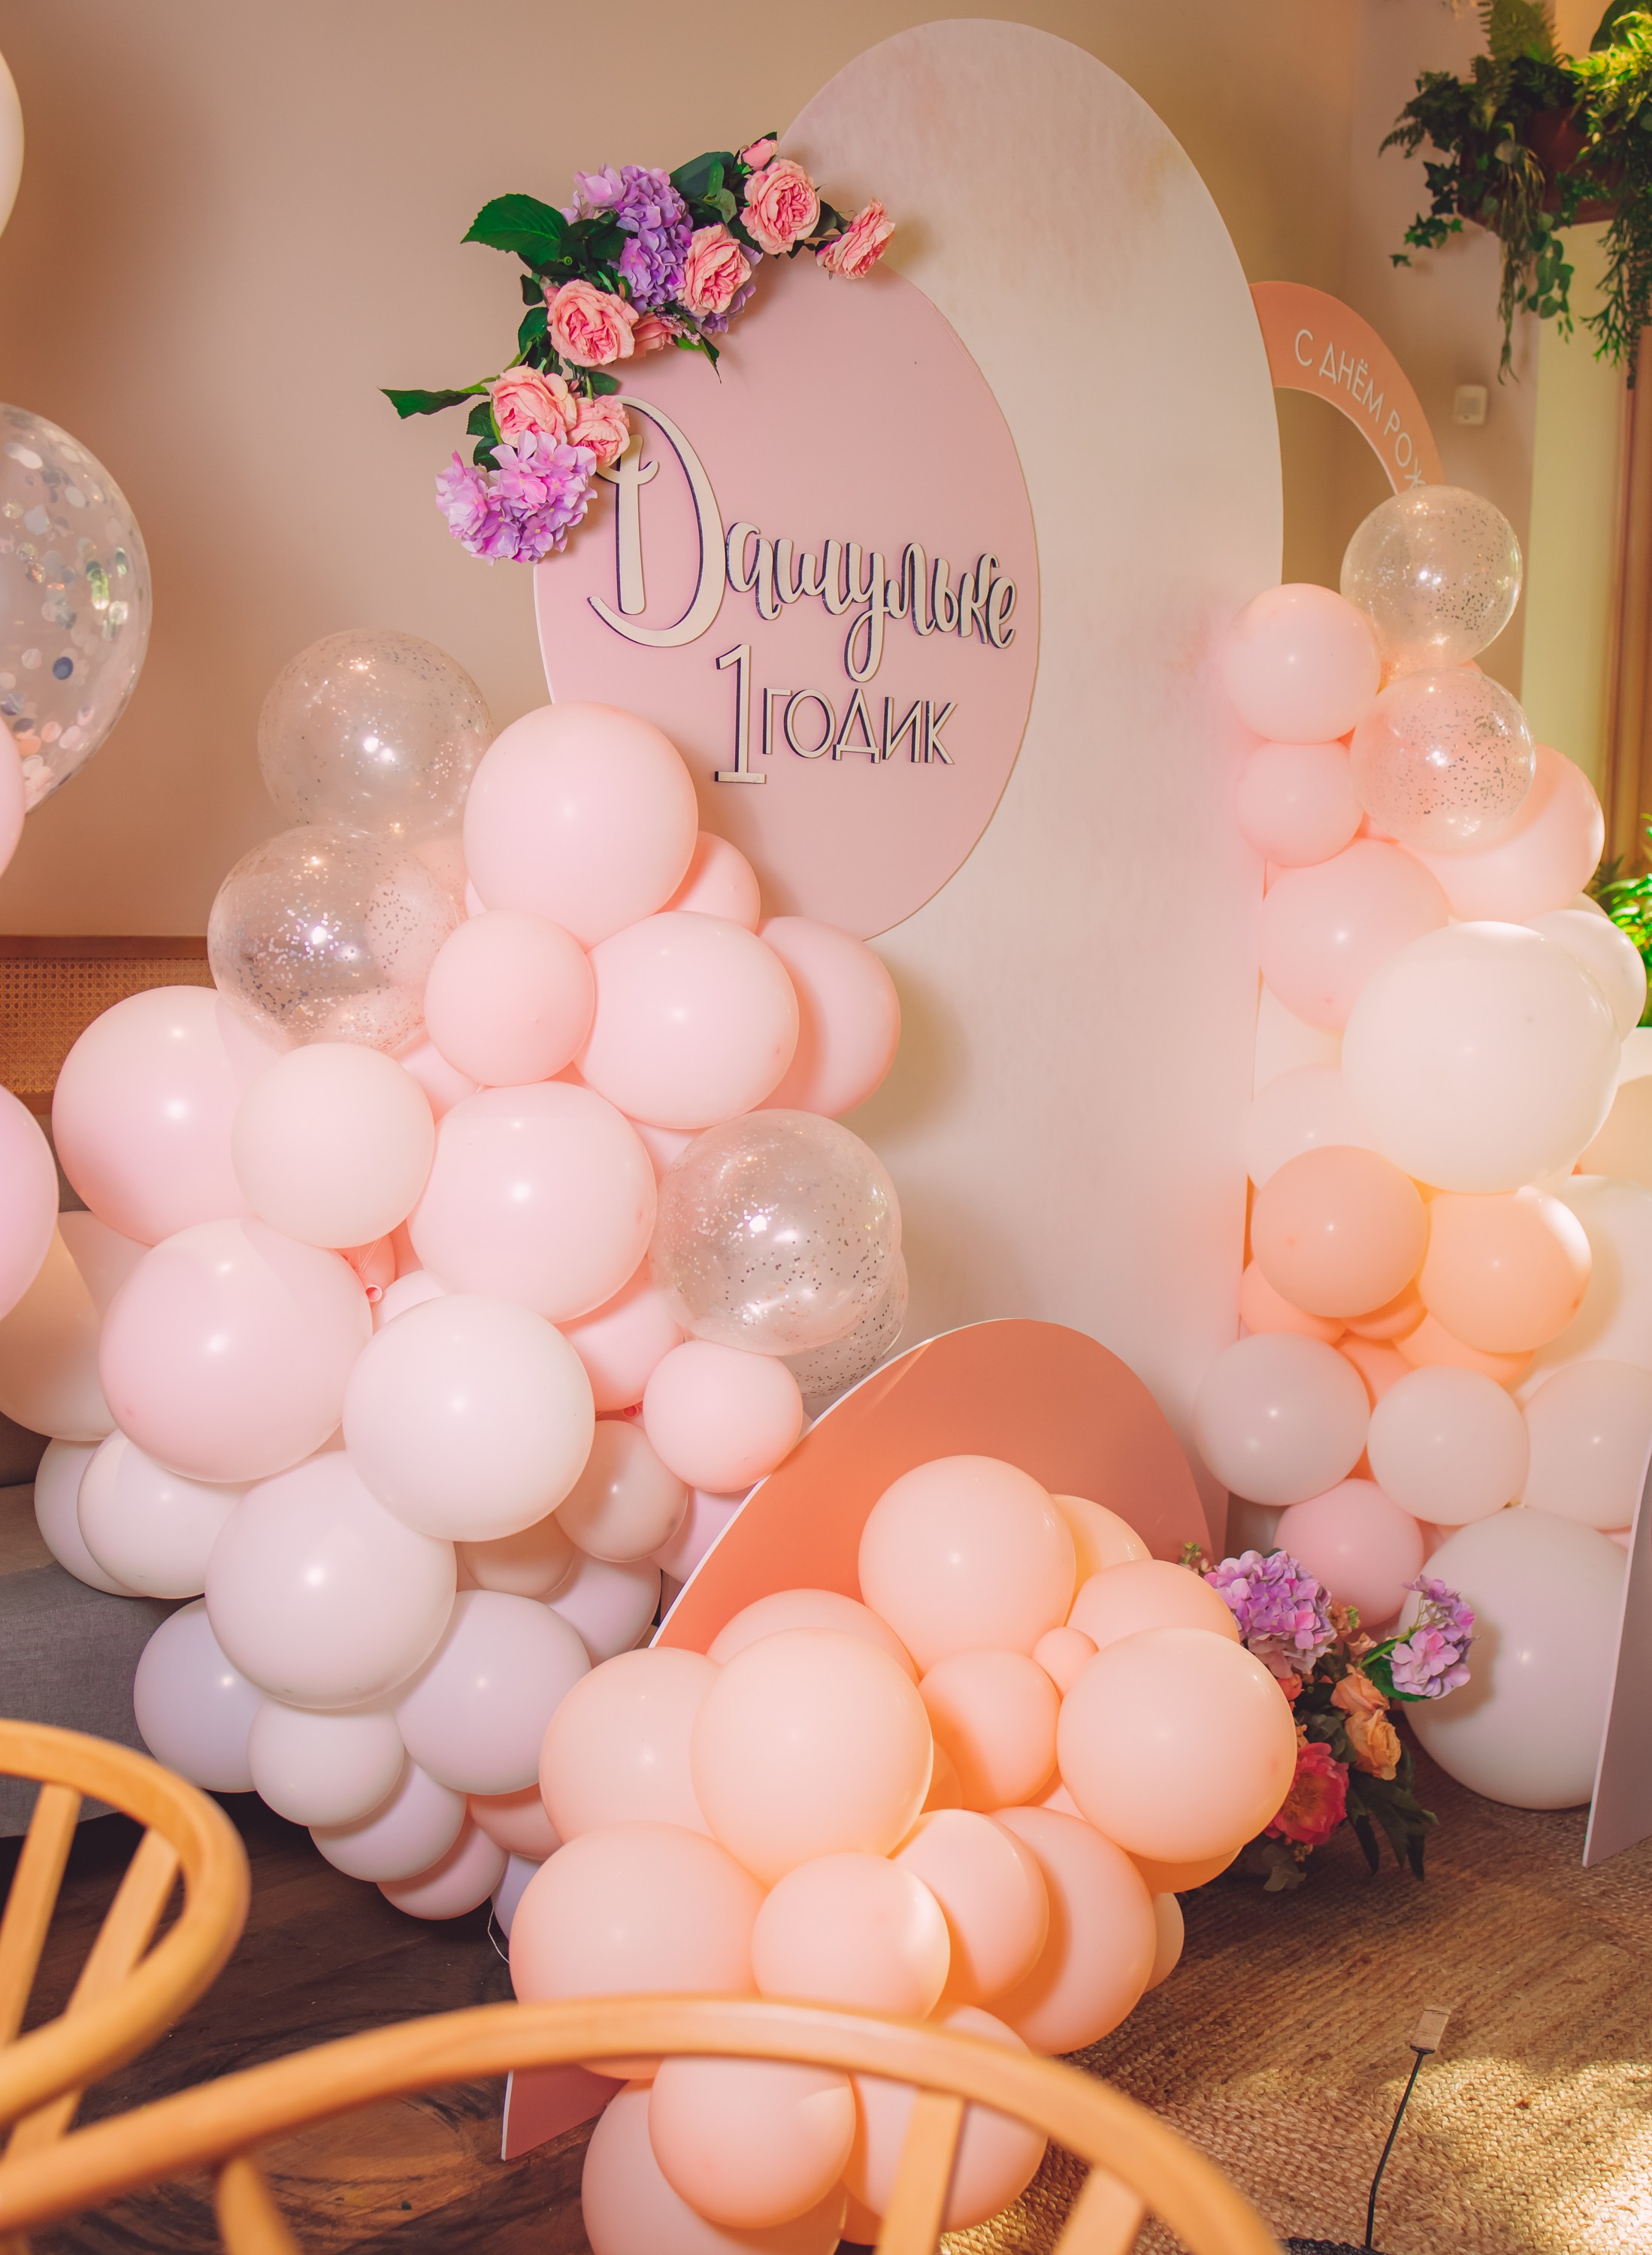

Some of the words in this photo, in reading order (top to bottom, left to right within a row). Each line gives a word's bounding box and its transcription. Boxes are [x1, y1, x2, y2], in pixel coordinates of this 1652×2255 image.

[1294, 328, 1314, 367] С
[1318, 342, 1384, 423] ДНЁМ
[586, 395, 1017, 683] Дашульке
[715, 644, 767, 784] 1
[761, 688, 958, 765] ГОДИК
